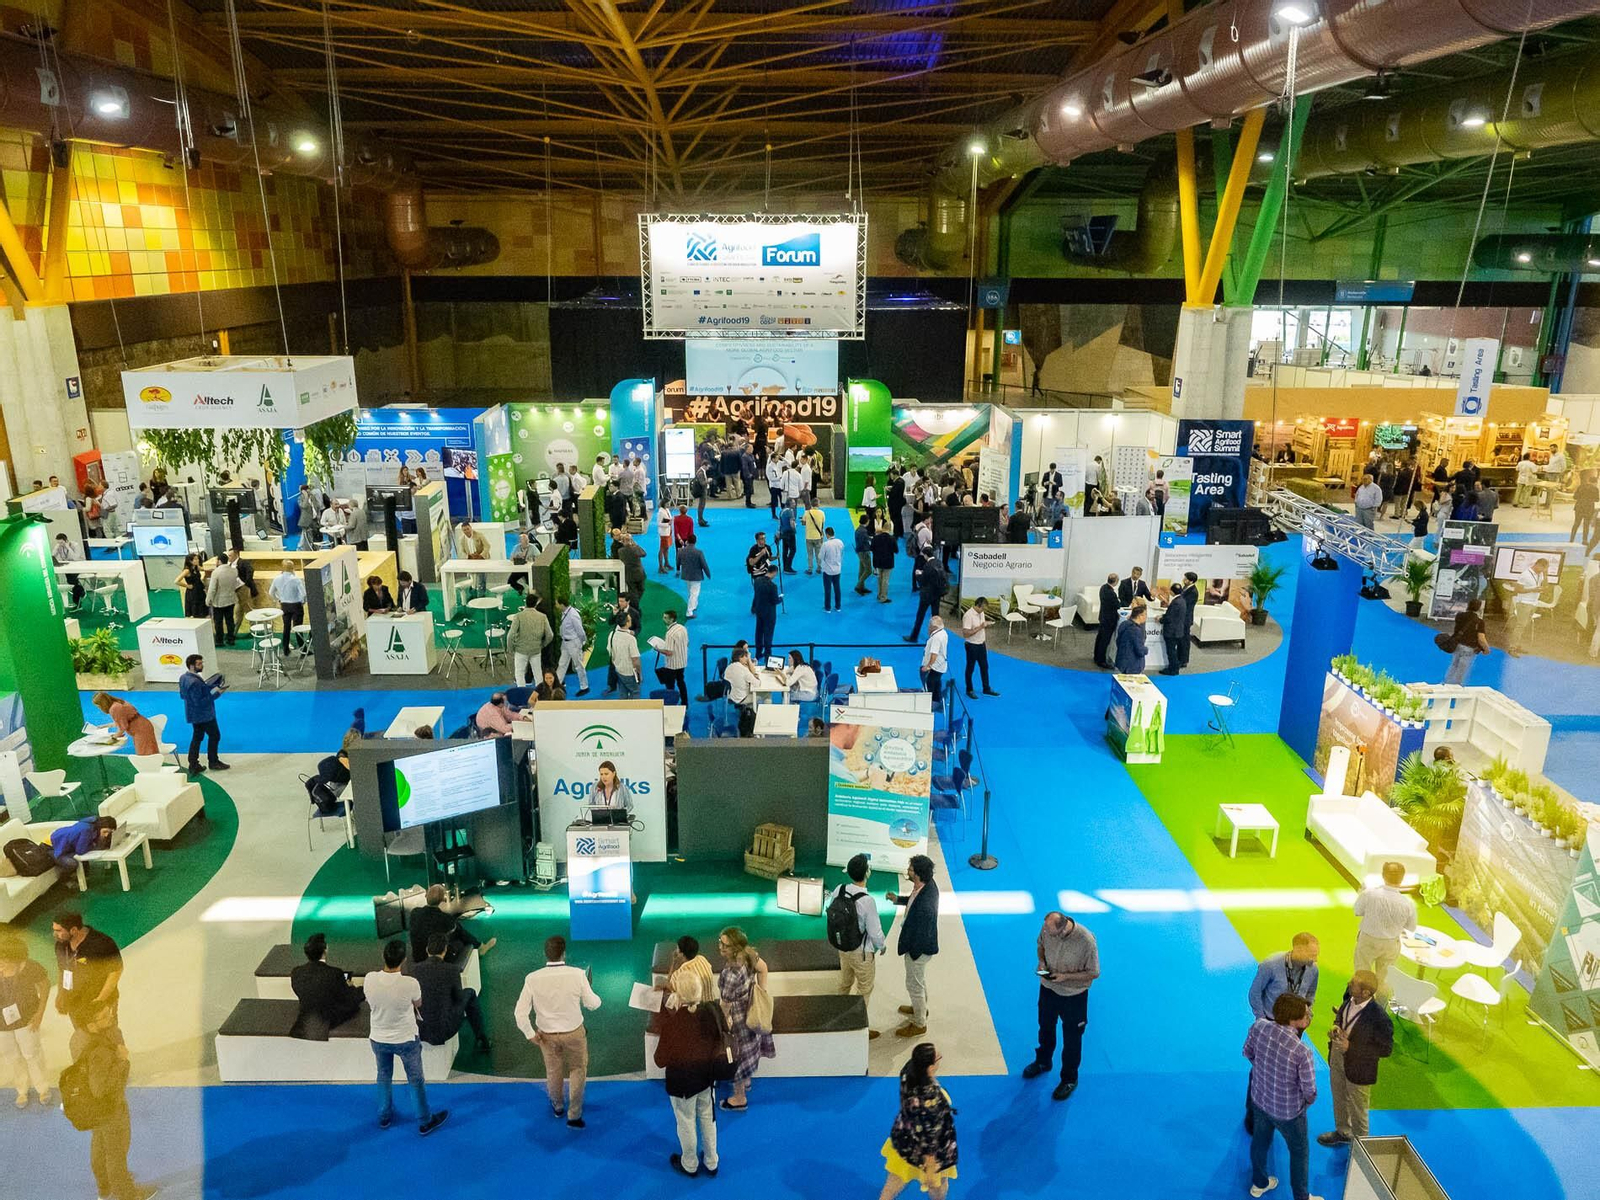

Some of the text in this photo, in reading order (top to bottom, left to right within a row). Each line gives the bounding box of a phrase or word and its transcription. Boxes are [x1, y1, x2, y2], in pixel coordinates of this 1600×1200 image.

[766, 247, 816, 263] Forum
[698, 315, 749, 325] #Agrifood19
[1475, 348, 1485, 366] Area
[1470, 368, 1483, 393] Tasting
[193, 394, 233, 406] Alltech
[1215, 430, 1242, 439] Smart
[1191, 473, 1233, 487] Tasting
[1195, 484, 1225, 495] Area
[972, 561, 1033, 569] Negocio Agrario
[152, 636, 183, 645] Alltech
